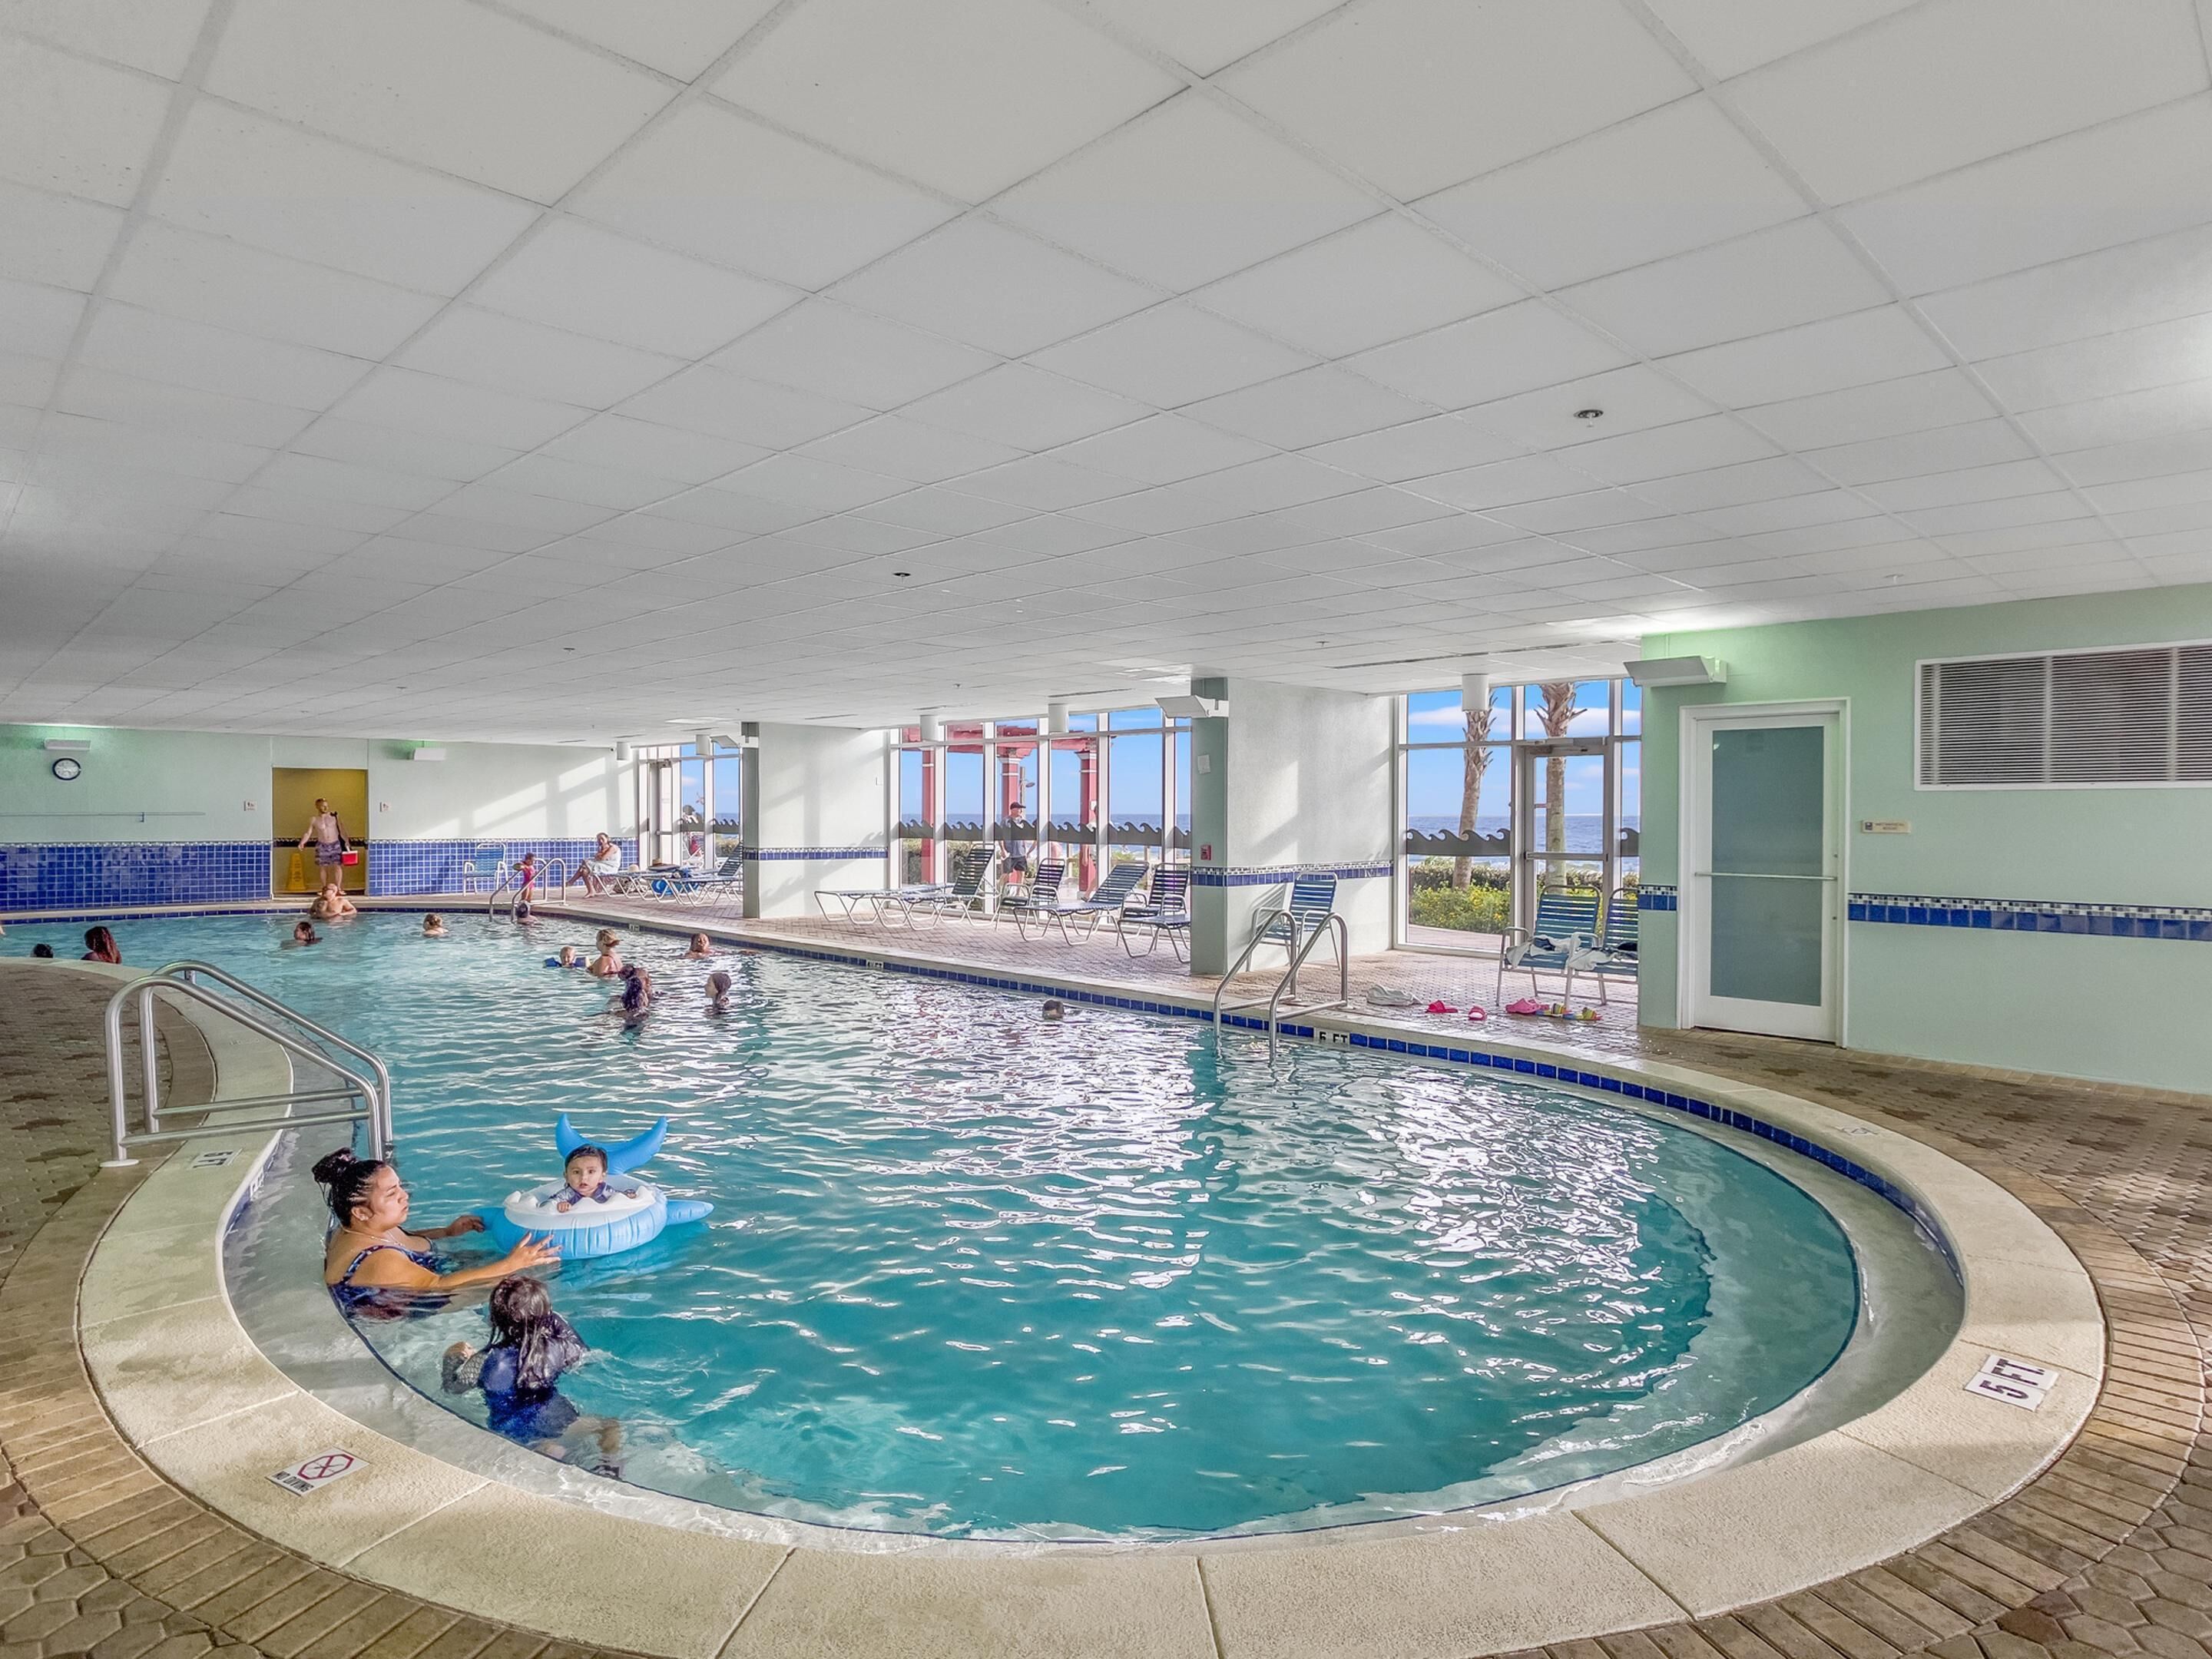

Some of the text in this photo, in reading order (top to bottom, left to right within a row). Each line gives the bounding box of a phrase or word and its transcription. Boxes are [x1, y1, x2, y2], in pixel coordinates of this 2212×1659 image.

[1333, 1033, 1348, 1044] FT
[1979, 1379, 2029, 1399] 5
[271, 1470, 315, 1493] NO DIVING
